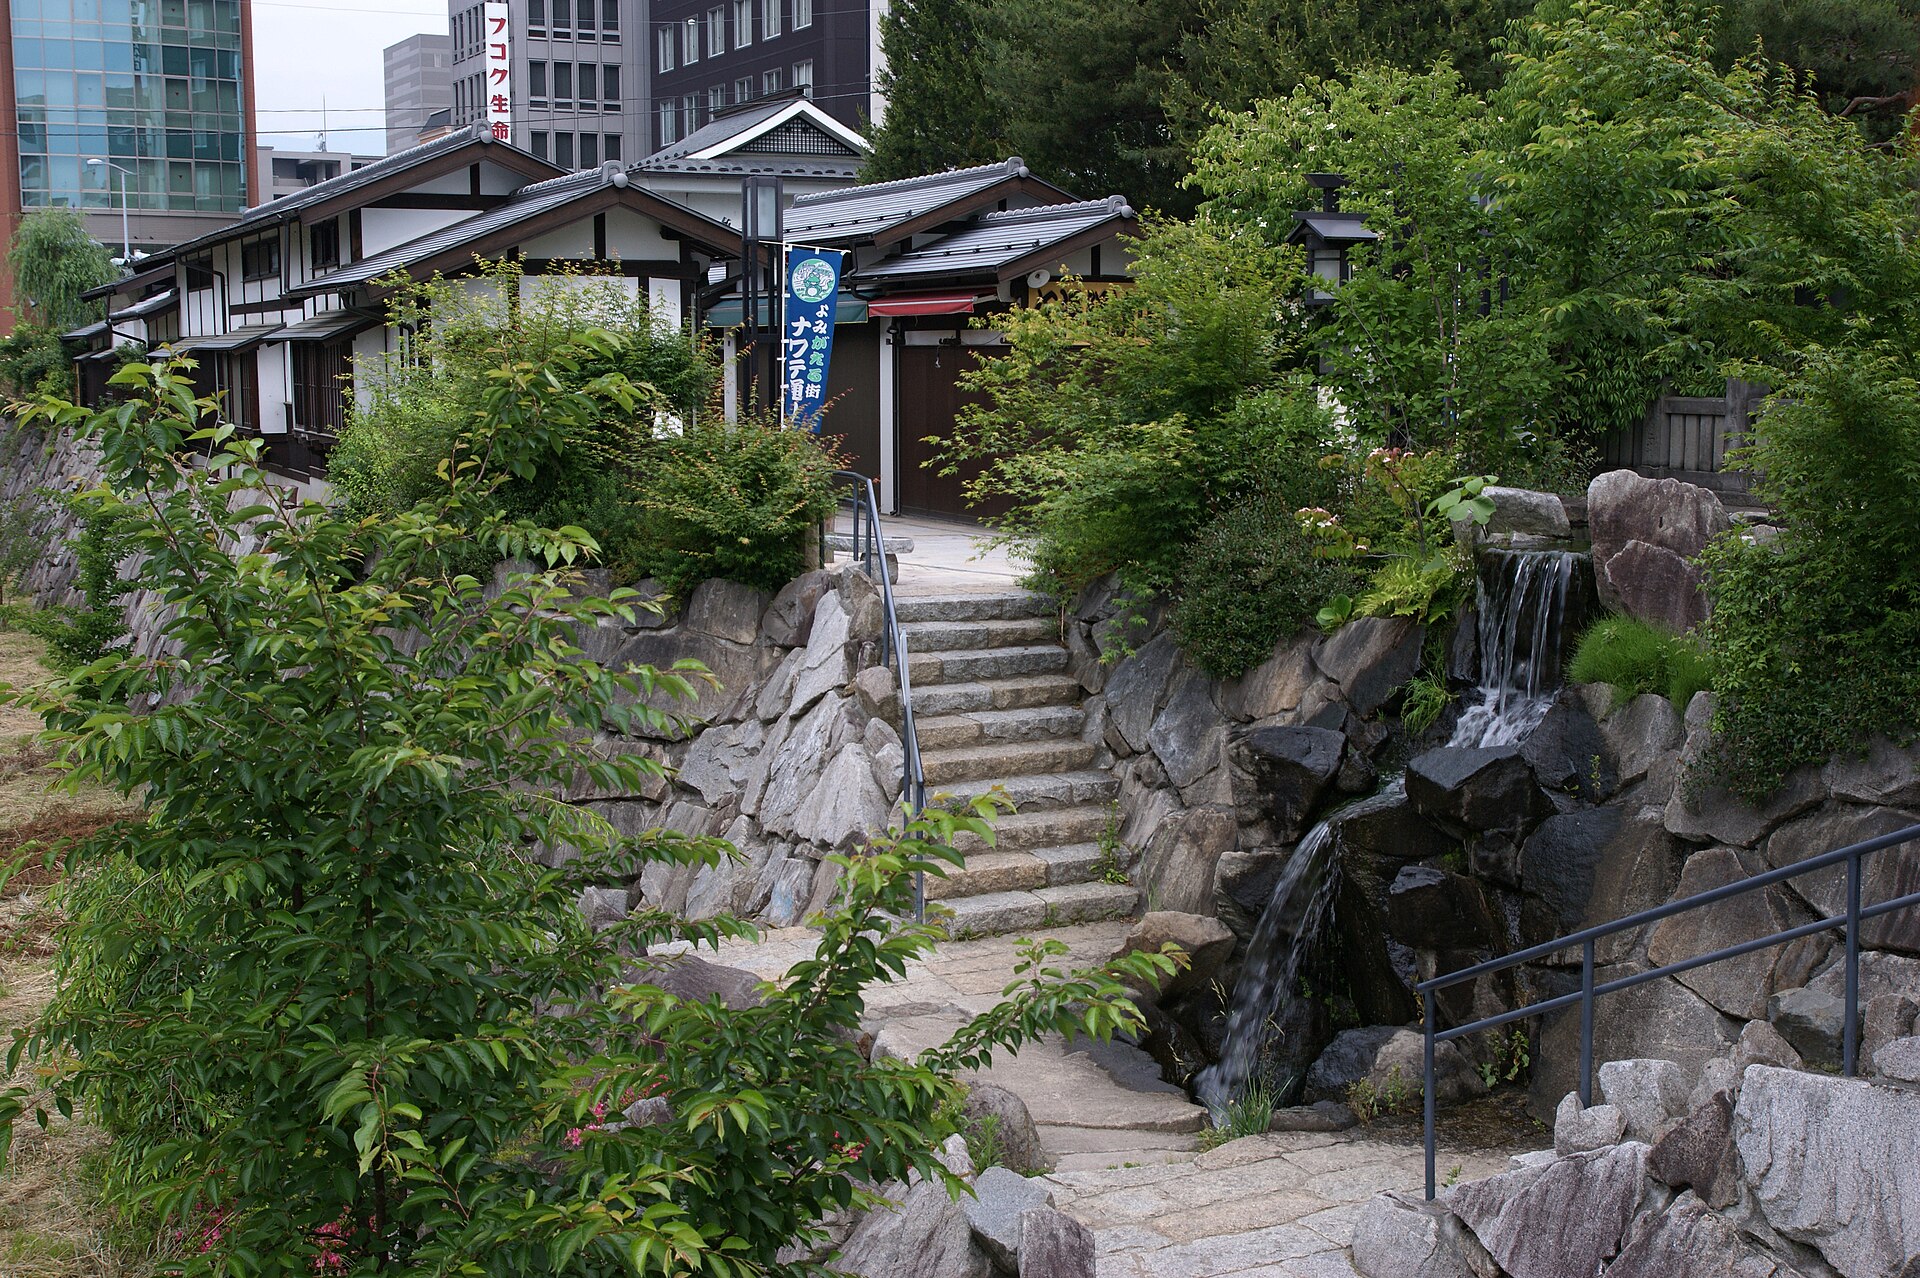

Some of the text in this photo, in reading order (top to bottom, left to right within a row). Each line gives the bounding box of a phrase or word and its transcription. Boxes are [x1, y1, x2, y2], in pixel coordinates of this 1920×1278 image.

[488, 17, 509, 140] フコク生命
[805, 304, 830, 399] よみがえる街
